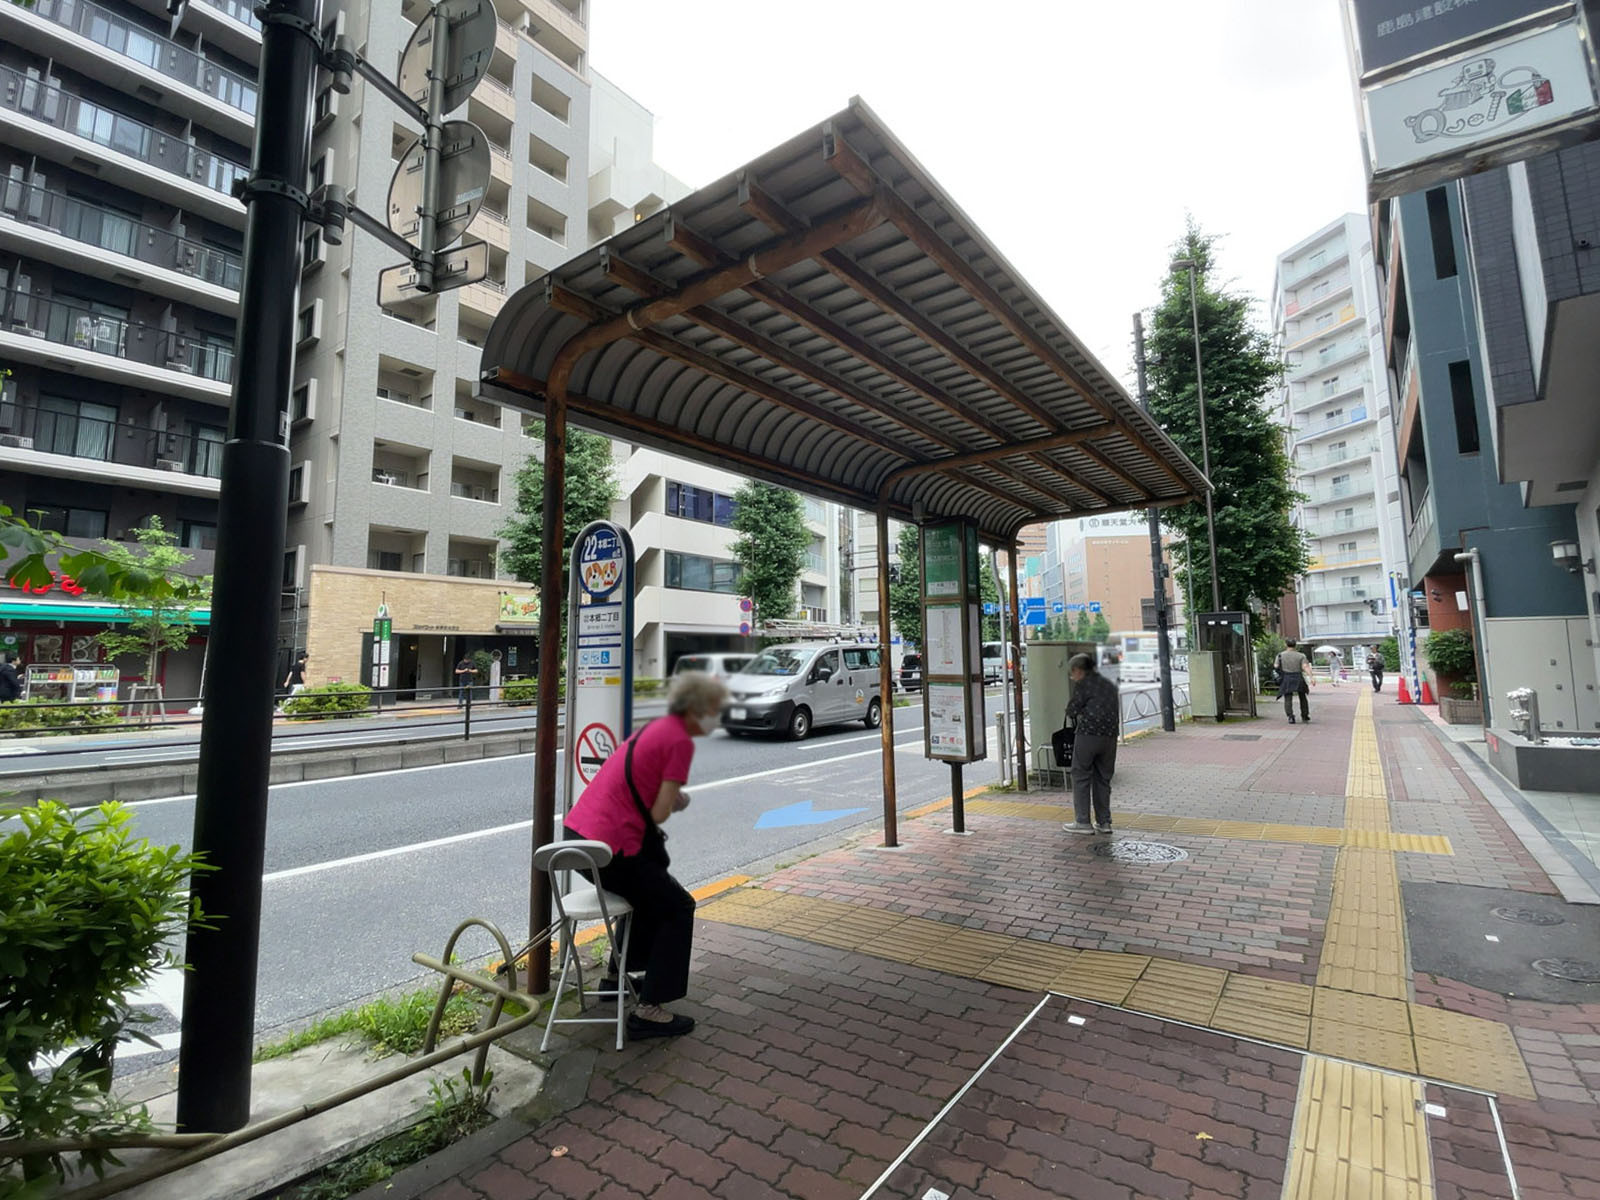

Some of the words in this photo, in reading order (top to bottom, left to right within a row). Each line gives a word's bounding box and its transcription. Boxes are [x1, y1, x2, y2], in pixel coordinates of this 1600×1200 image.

[1377, 0, 1479, 37] 鹿島建設
[584, 535, 597, 560] 22
